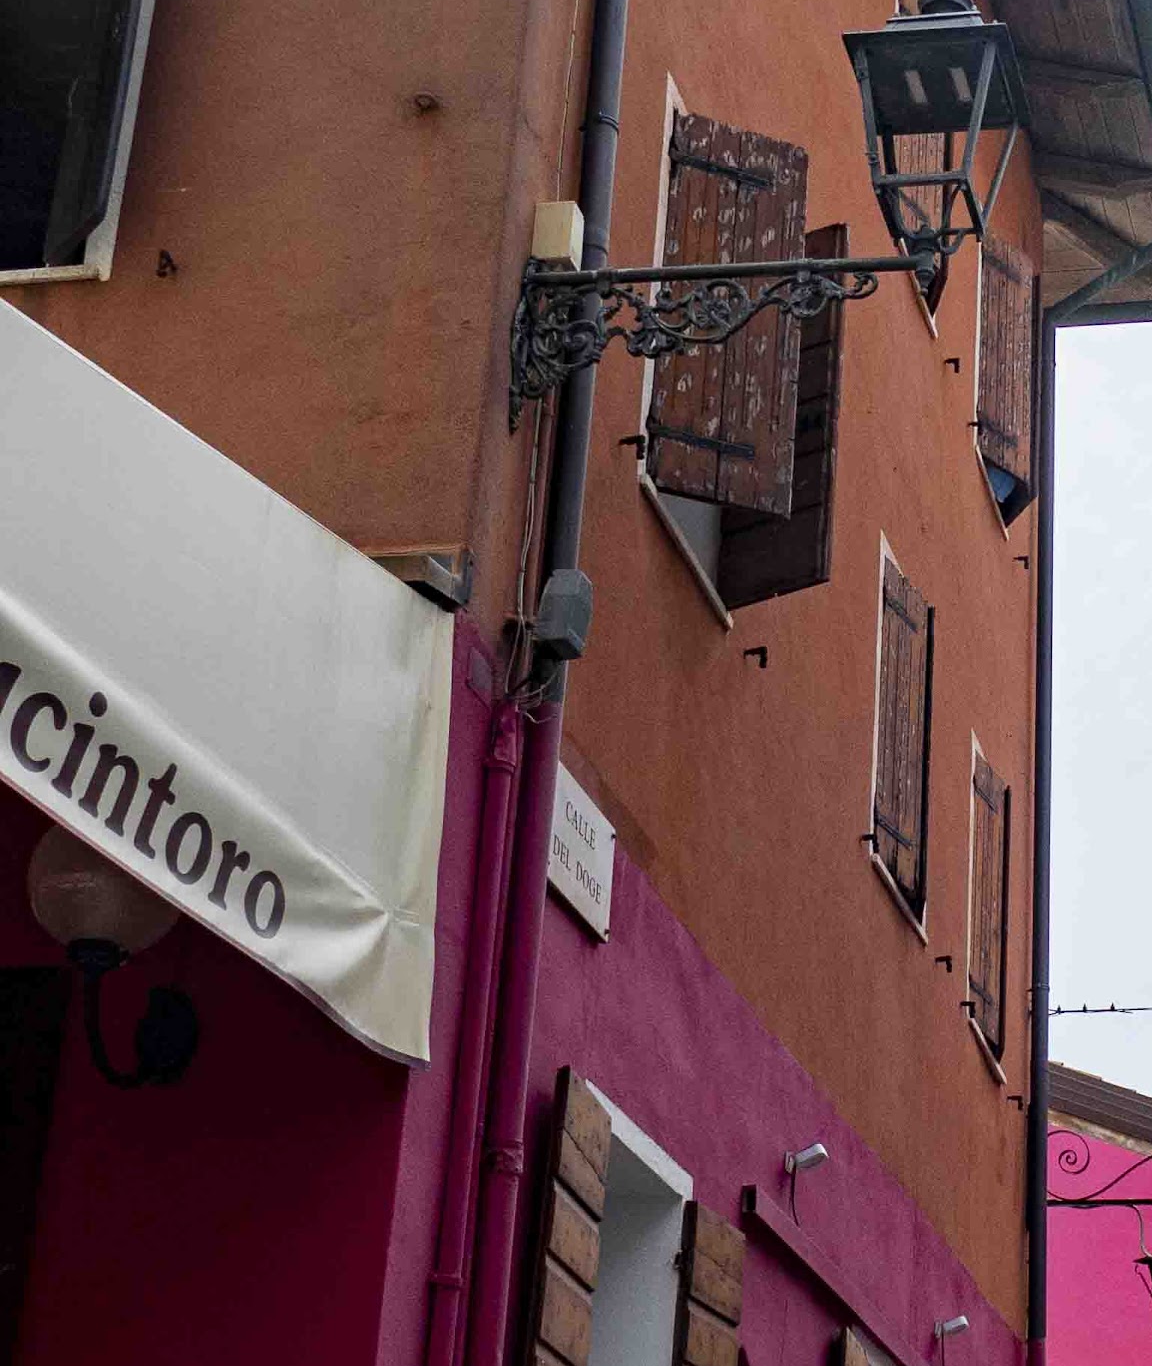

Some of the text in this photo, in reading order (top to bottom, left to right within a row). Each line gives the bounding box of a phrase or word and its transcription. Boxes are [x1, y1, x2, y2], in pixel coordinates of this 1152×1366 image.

[566, 801, 596, 850] CALLE
[553, 834, 602, 904] DEL DOGE
